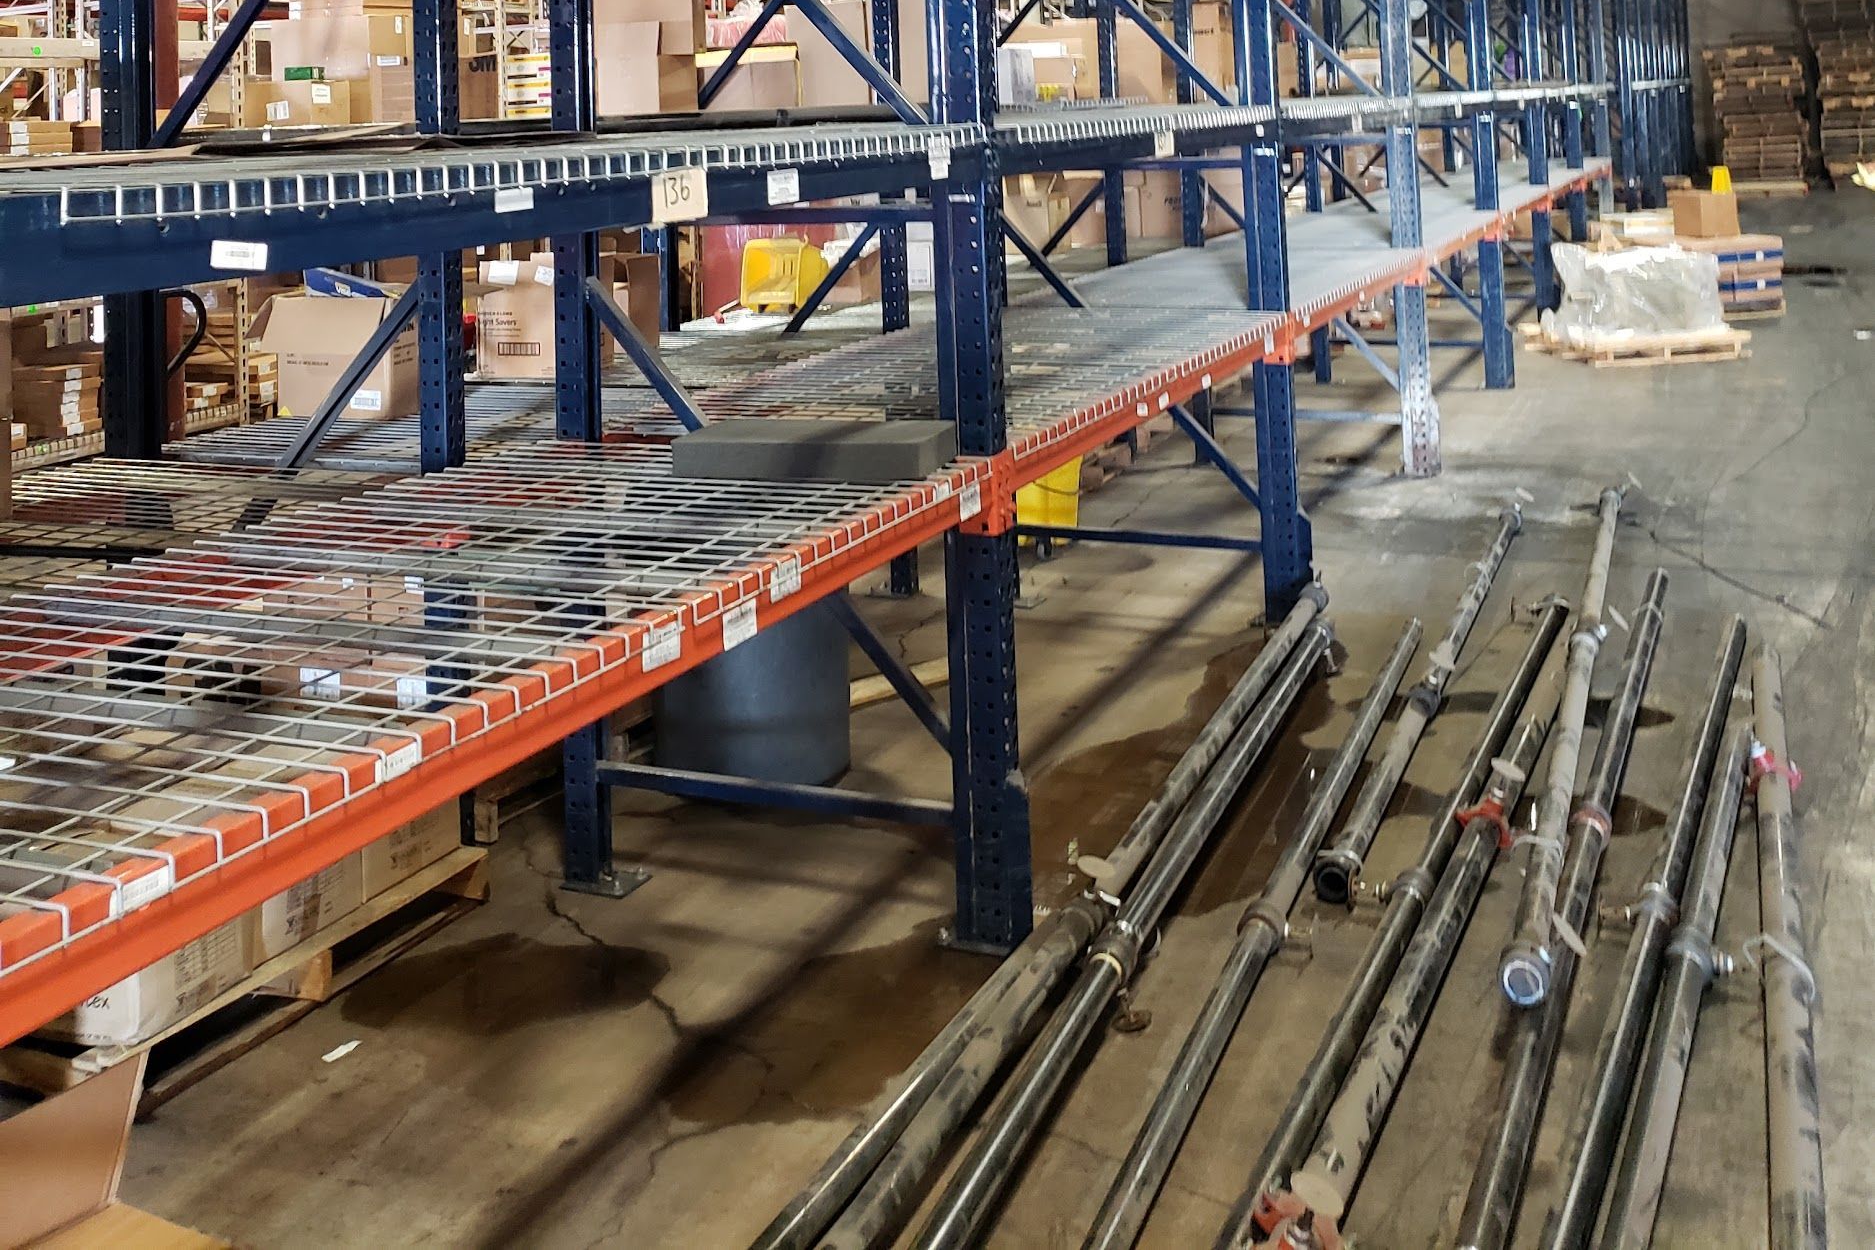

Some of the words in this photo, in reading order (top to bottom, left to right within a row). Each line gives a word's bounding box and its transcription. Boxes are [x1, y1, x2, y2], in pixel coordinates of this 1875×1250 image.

[469, 54, 497, 73] 3M
[662, 173, 691, 209] 136
[495, 318, 517, 327] Savers
